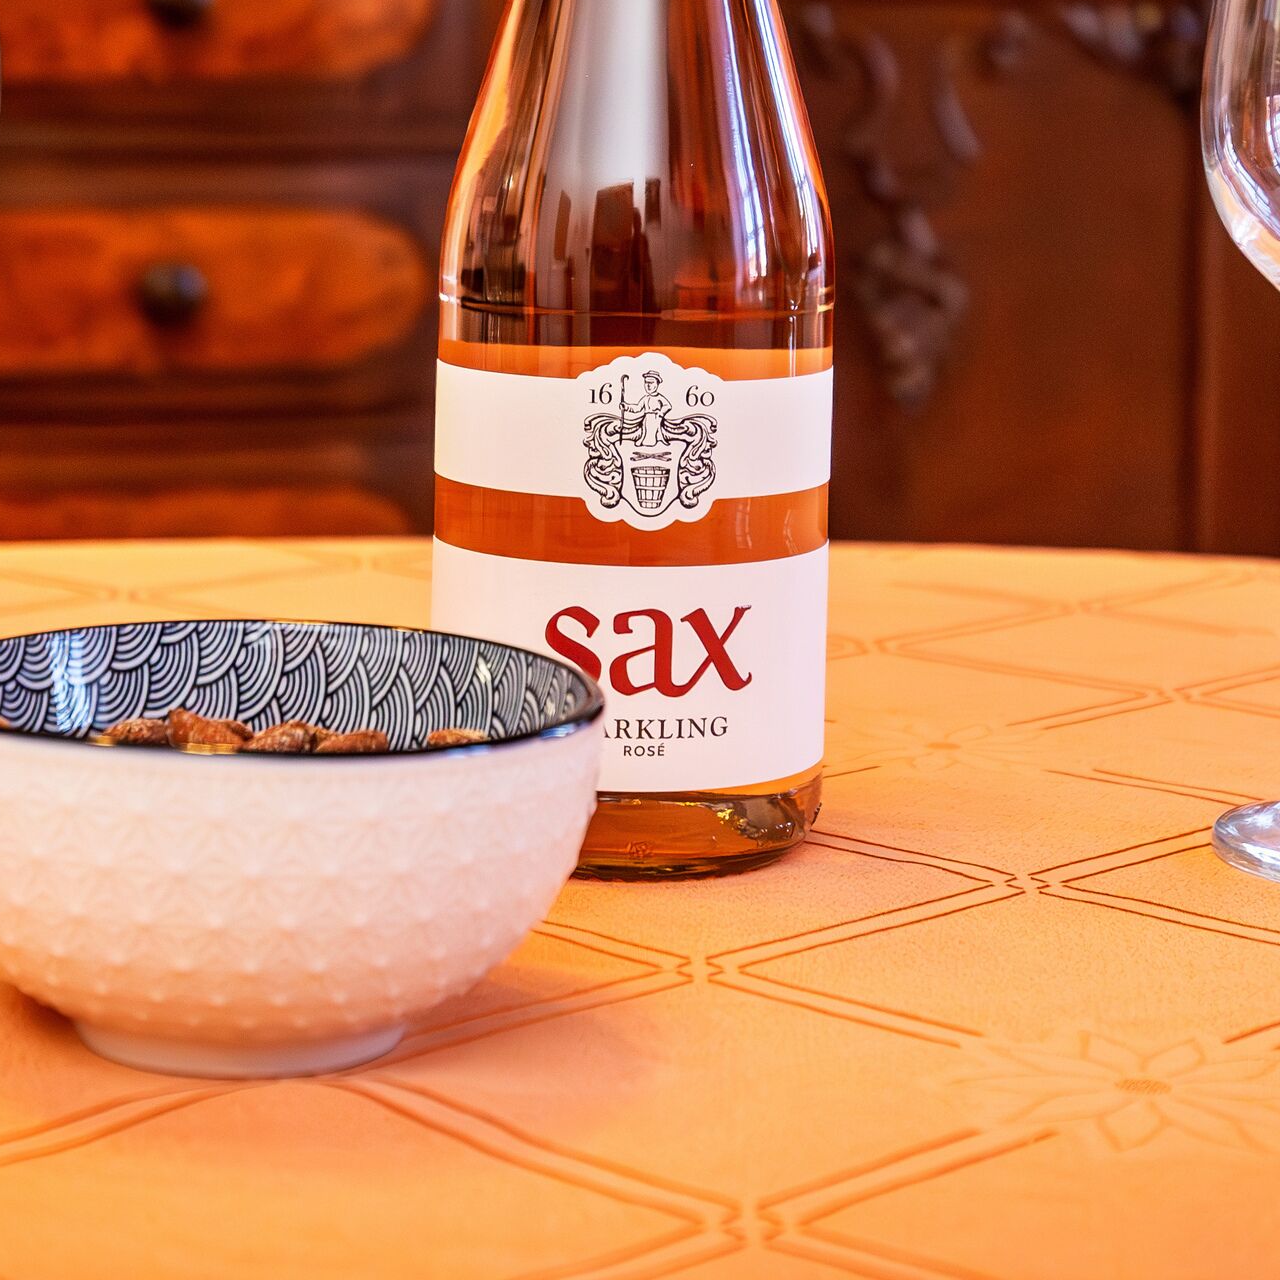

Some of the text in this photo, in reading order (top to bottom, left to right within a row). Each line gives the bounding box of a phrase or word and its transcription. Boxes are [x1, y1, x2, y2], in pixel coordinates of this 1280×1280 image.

[588, 382, 715, 407] 16 60
[544, 605, 753, 698] sax
[623, 742, 665, 757] ROSÉ
